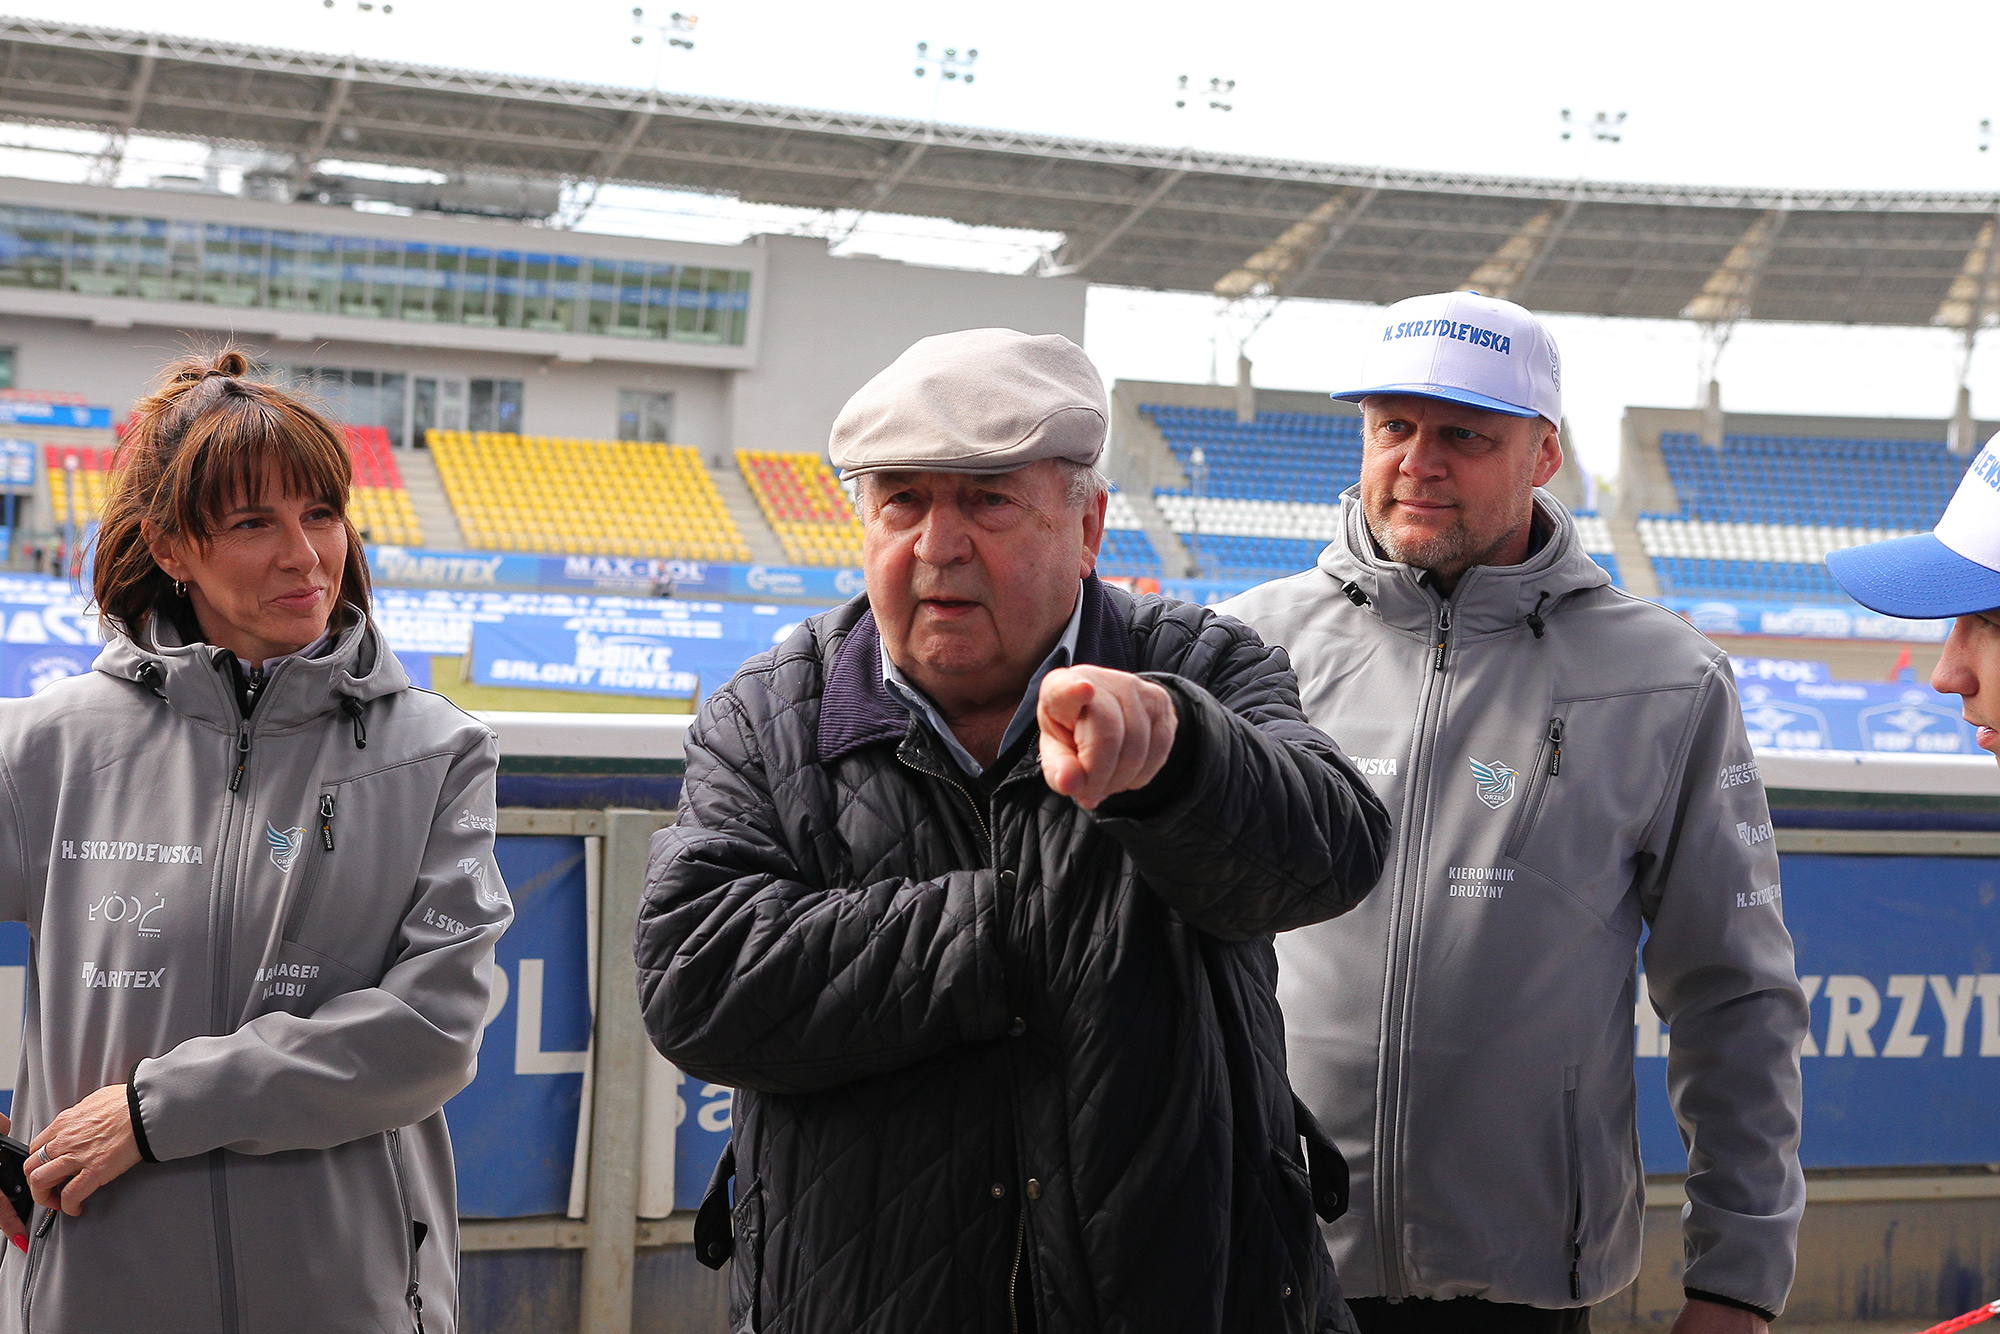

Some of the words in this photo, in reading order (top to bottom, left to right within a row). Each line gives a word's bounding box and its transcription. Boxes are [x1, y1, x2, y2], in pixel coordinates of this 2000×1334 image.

[1383, 326, 1393, 342] H.
[1395, 319, 1511, 356] SKRZYDLEWSKA
[61, 840, 77, 860] H.
[79, 840, 203, 865] SKRZYDLEWSKA
[1449, 866, 1515, 881] KIEROWNIK
[1449, 881, 1504, 899] DRUŻYNY
[81, 961, 167, 989] VARITEX
